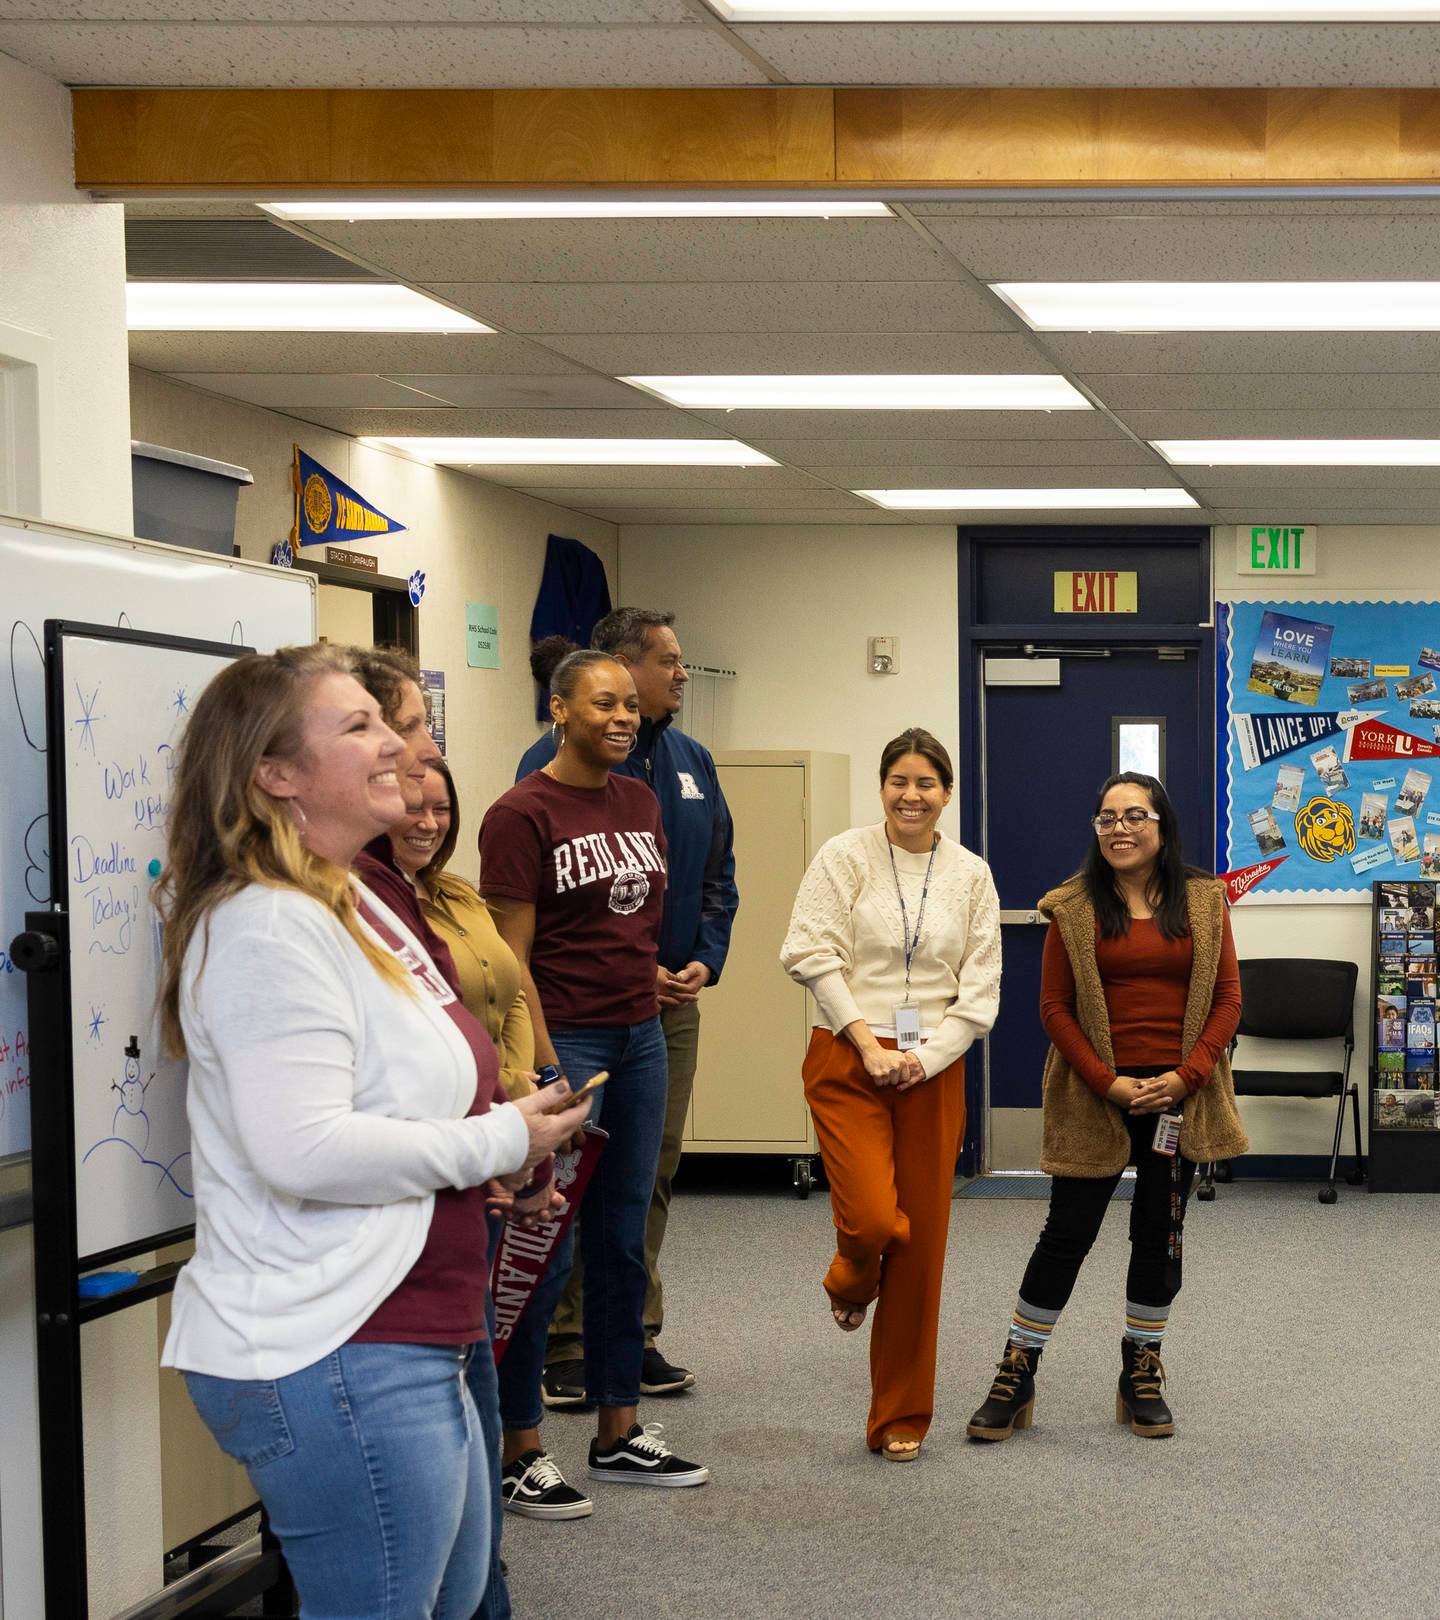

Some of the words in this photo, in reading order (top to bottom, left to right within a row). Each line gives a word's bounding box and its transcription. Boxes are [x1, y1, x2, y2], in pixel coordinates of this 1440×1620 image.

[1250, 527, 1305, 570] EXIT
[1071, 571, 1119, 612] EXIT
[1271, 647, 1311, 665] LEARN
[1273, 639, 1297, 651] WHERE
[1298, 646, 1312, 655] YOU
[1274, 627, 1315, 648] LOVE
[1256, 717, 1307, 758] LANCE
[1308, 716, 1333, 737] UP!
[1360, 730, 1395, 744] YORK
[103, 754, 151, 800] Work
[71, 835, 137, 883] Deadline
[1230, 863, 1271, 893] Nebraska
[84, 885, 139, 950] Today!
